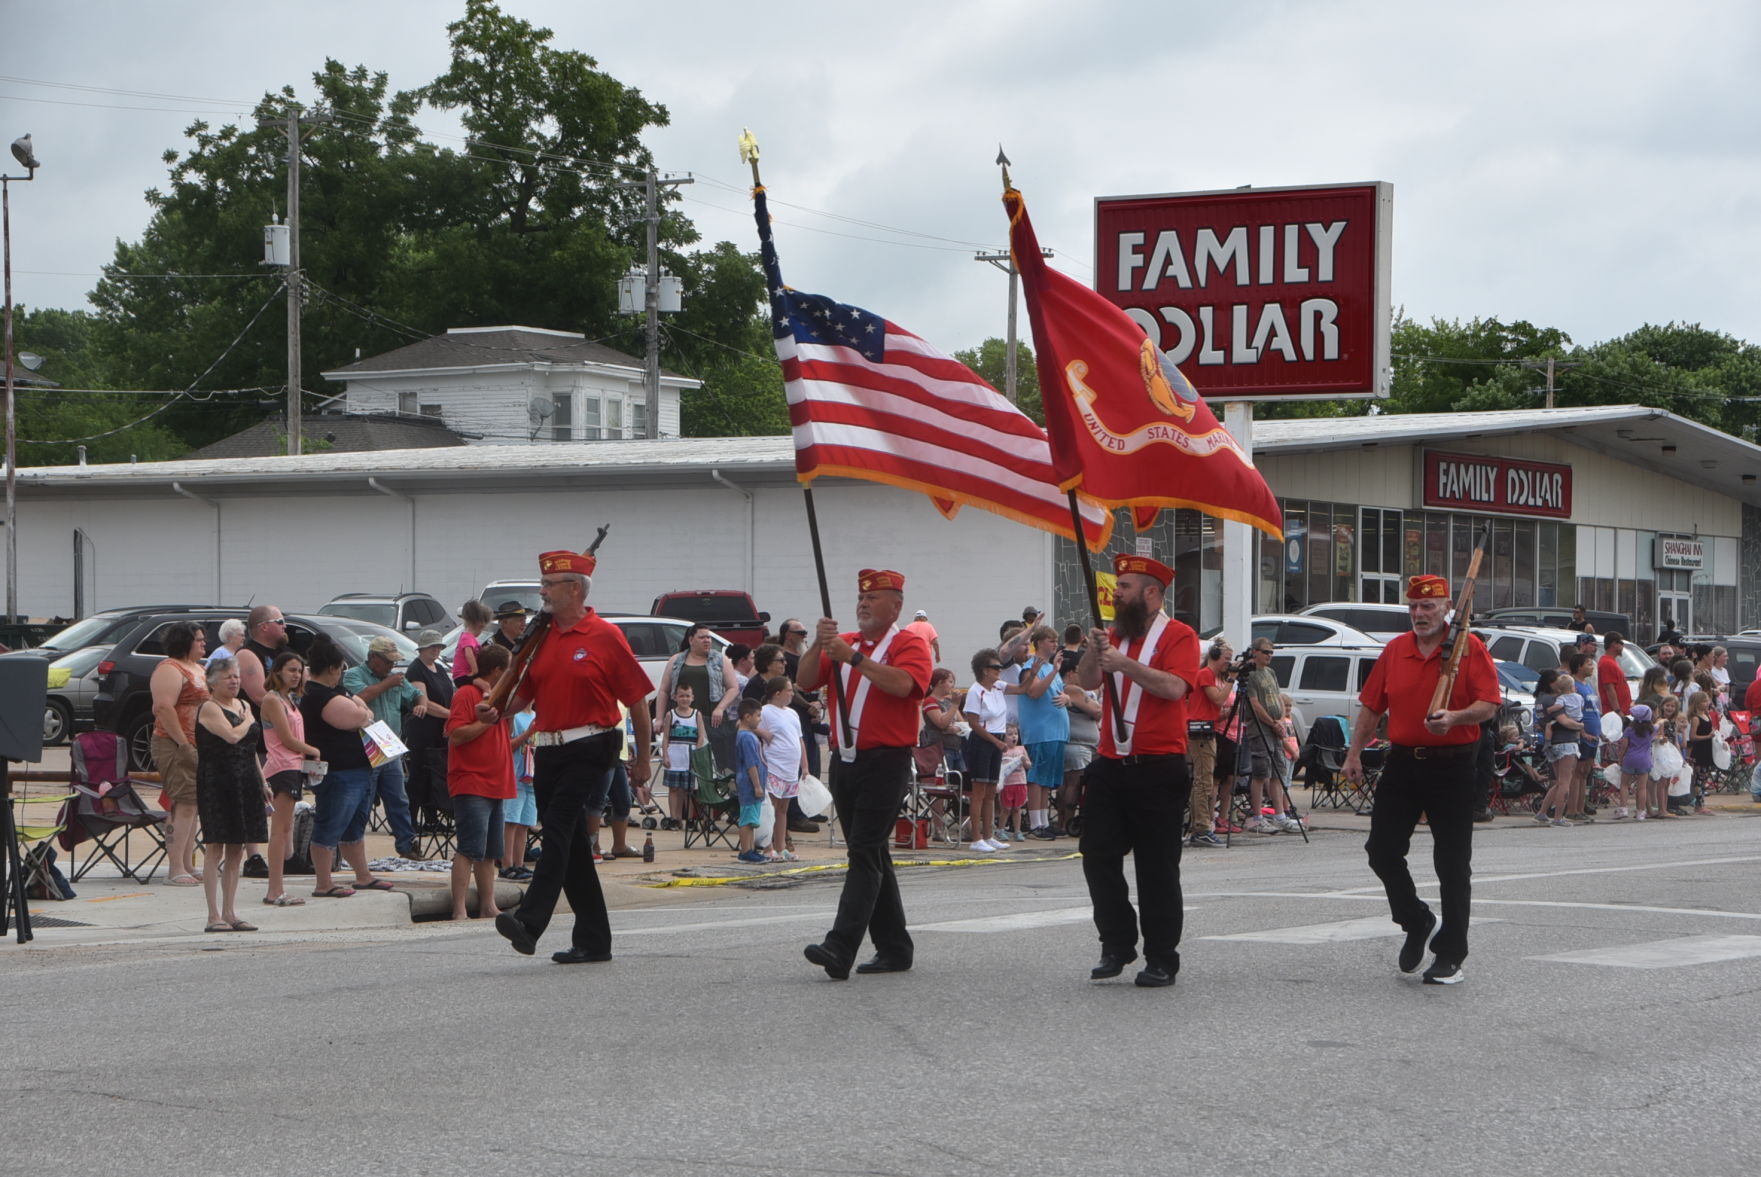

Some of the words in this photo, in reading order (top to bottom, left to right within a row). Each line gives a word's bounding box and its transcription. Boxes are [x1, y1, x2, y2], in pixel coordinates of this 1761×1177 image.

[1117, 221, 1348, 292] FAMILY
[1083, 412, 1126, 451] UNITED
[1148, 425, 1190, 449] STATES
[1438, 461, 1498, 502] FAMILY
[1507, 468, 1563, 508] DOLLAR
[1665, 542, 1692, 555] SHANGHAI
[1693, 543, 1703, 556] INN
[1665, 555, 1680, 566] Chinese
[1681, 556, 1702, 567] Restaurant
